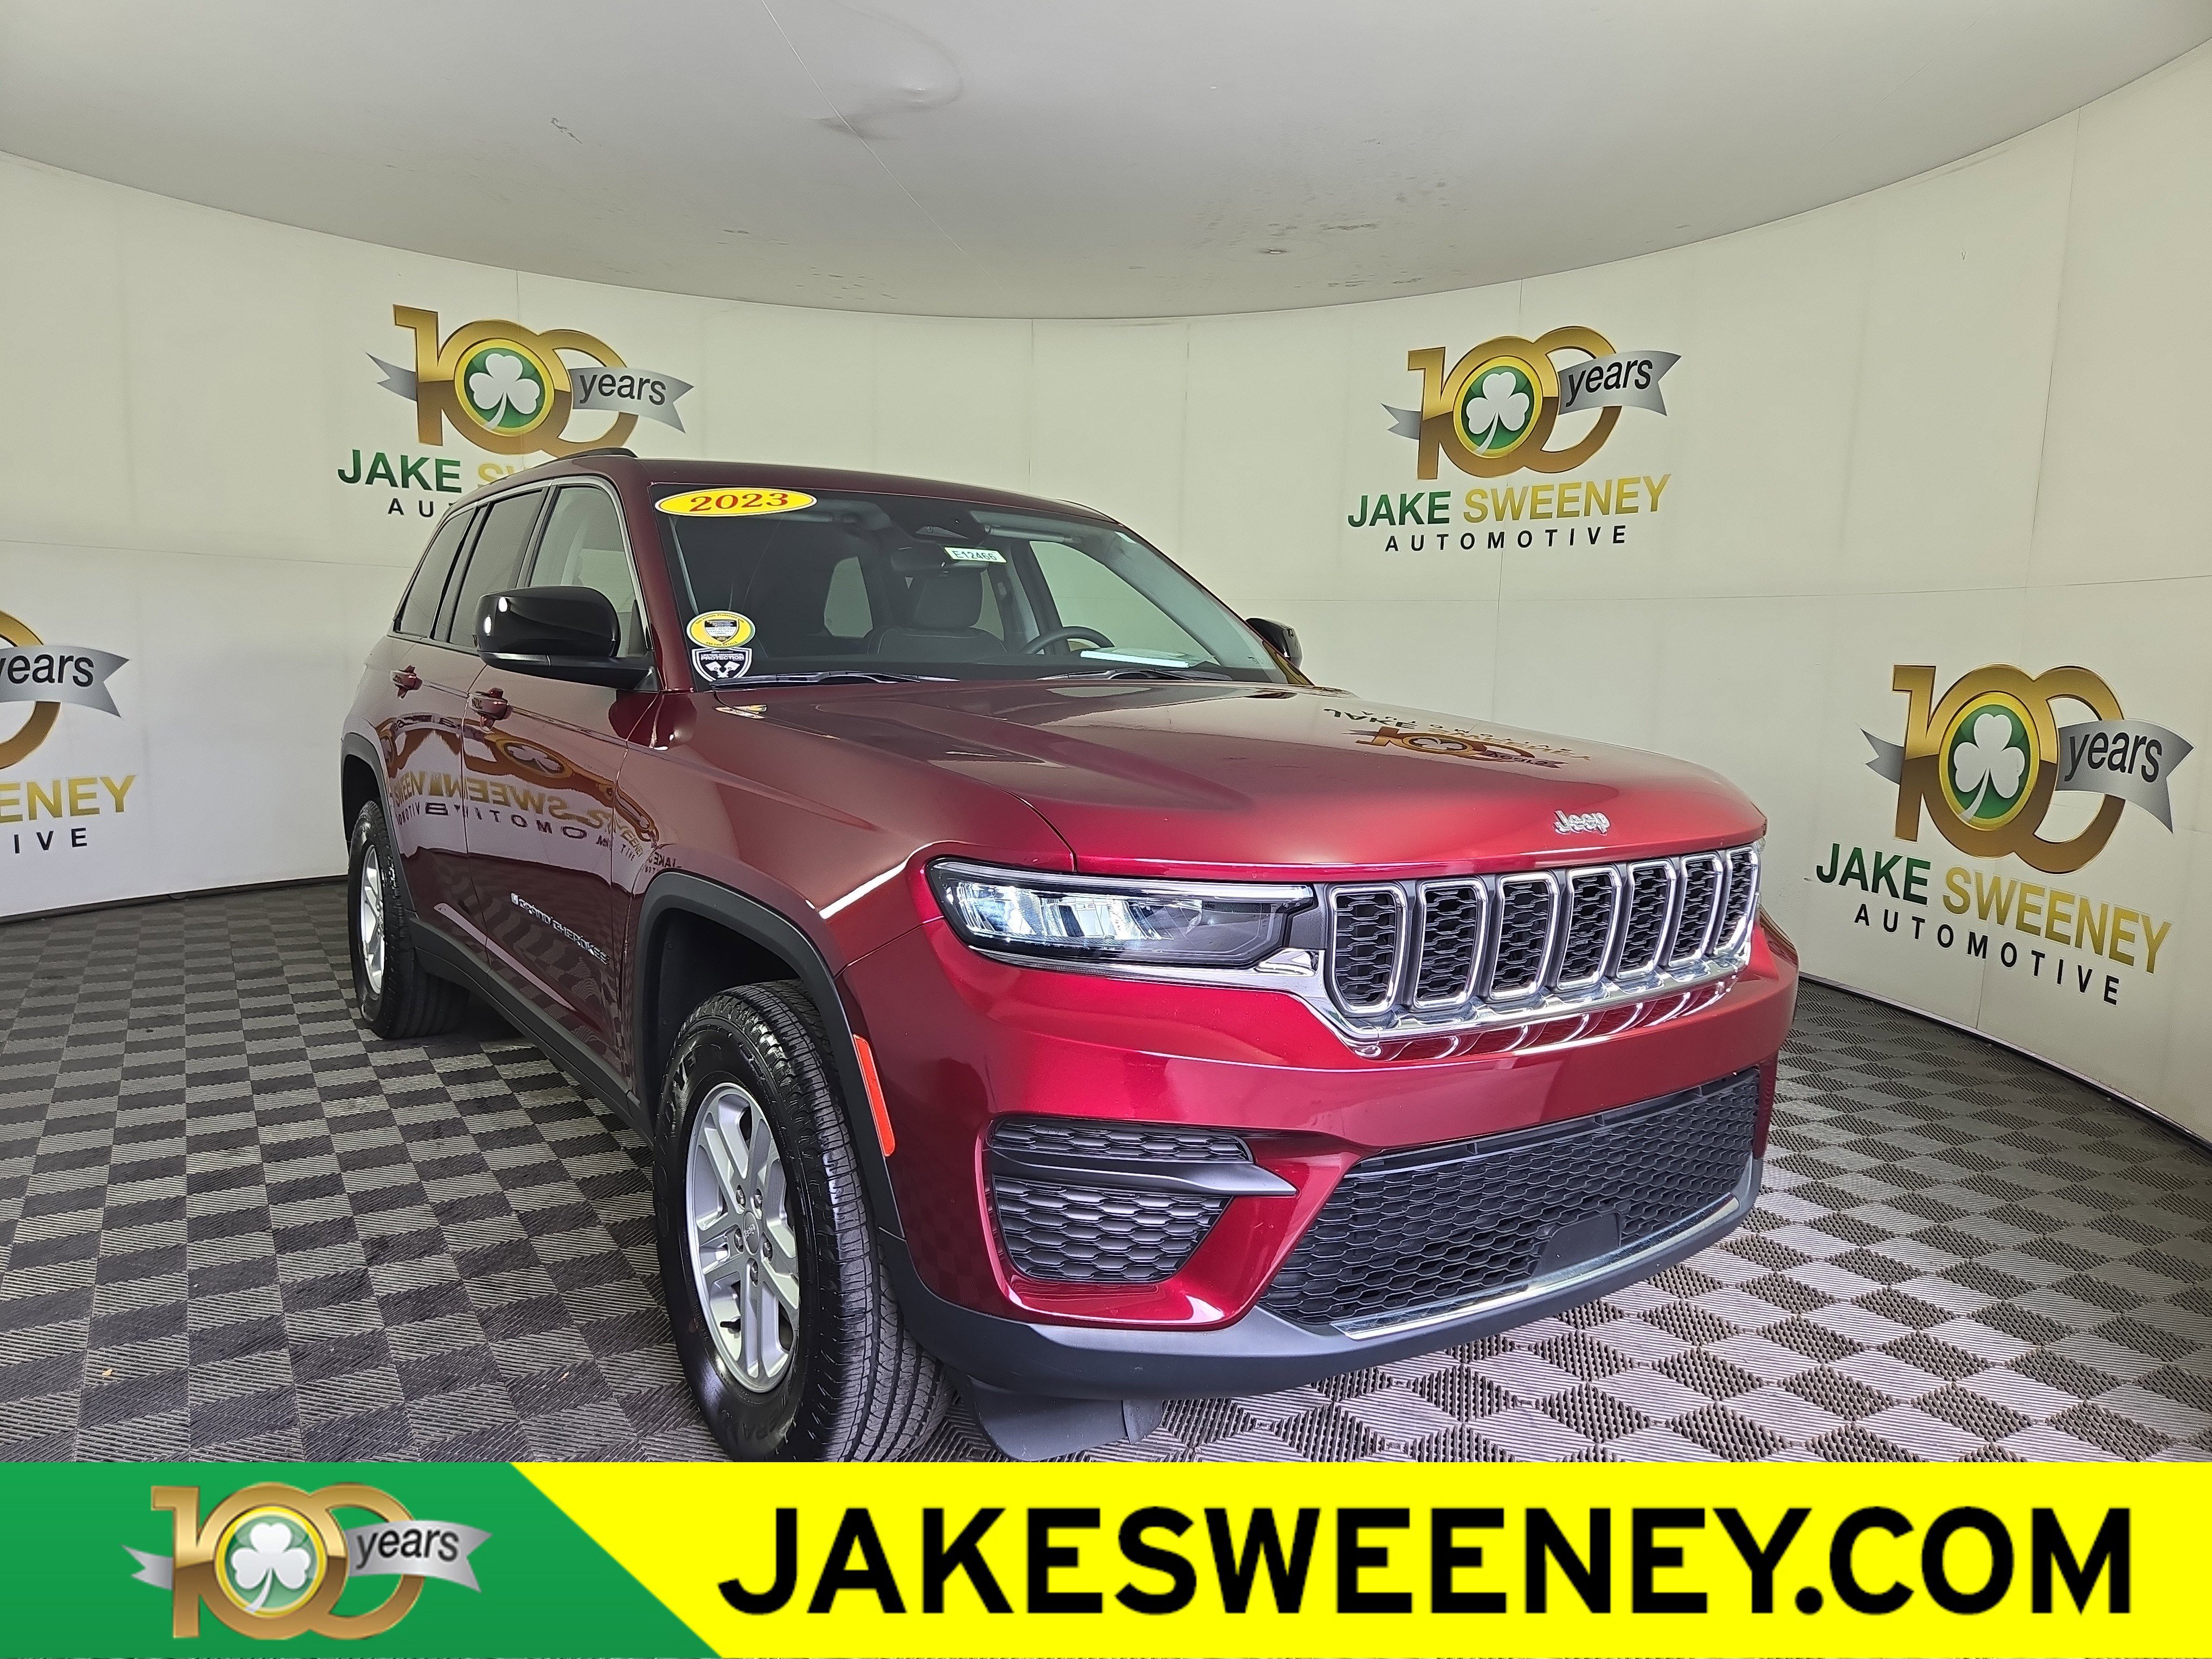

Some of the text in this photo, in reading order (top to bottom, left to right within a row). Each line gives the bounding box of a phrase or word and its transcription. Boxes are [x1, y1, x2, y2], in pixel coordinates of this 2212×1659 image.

[578, 369, 667, 406] years
[1566, 359, 1653, 408] years
[338, 449, 462, 493] JAKE
[388, 498, 459, 517] AU
[689, 493, 789, 512] 2023
[1348, 473, 1671, 528] JAKE SWEENEY
[952, 551, 997, 561] E12466
[1385, 525, 1626, 552] AUTOMOTIVE
[2064, 731, 2163, 783] years
[1554, 810, 1610, 834] Jeep
[1816, 843, 2172, 975] JAKE SWEENEY
[518, 898, 610, 965] GRAND CHEROKEE
[1855, 903, 2120, 1006] AUTOMOTIVE
